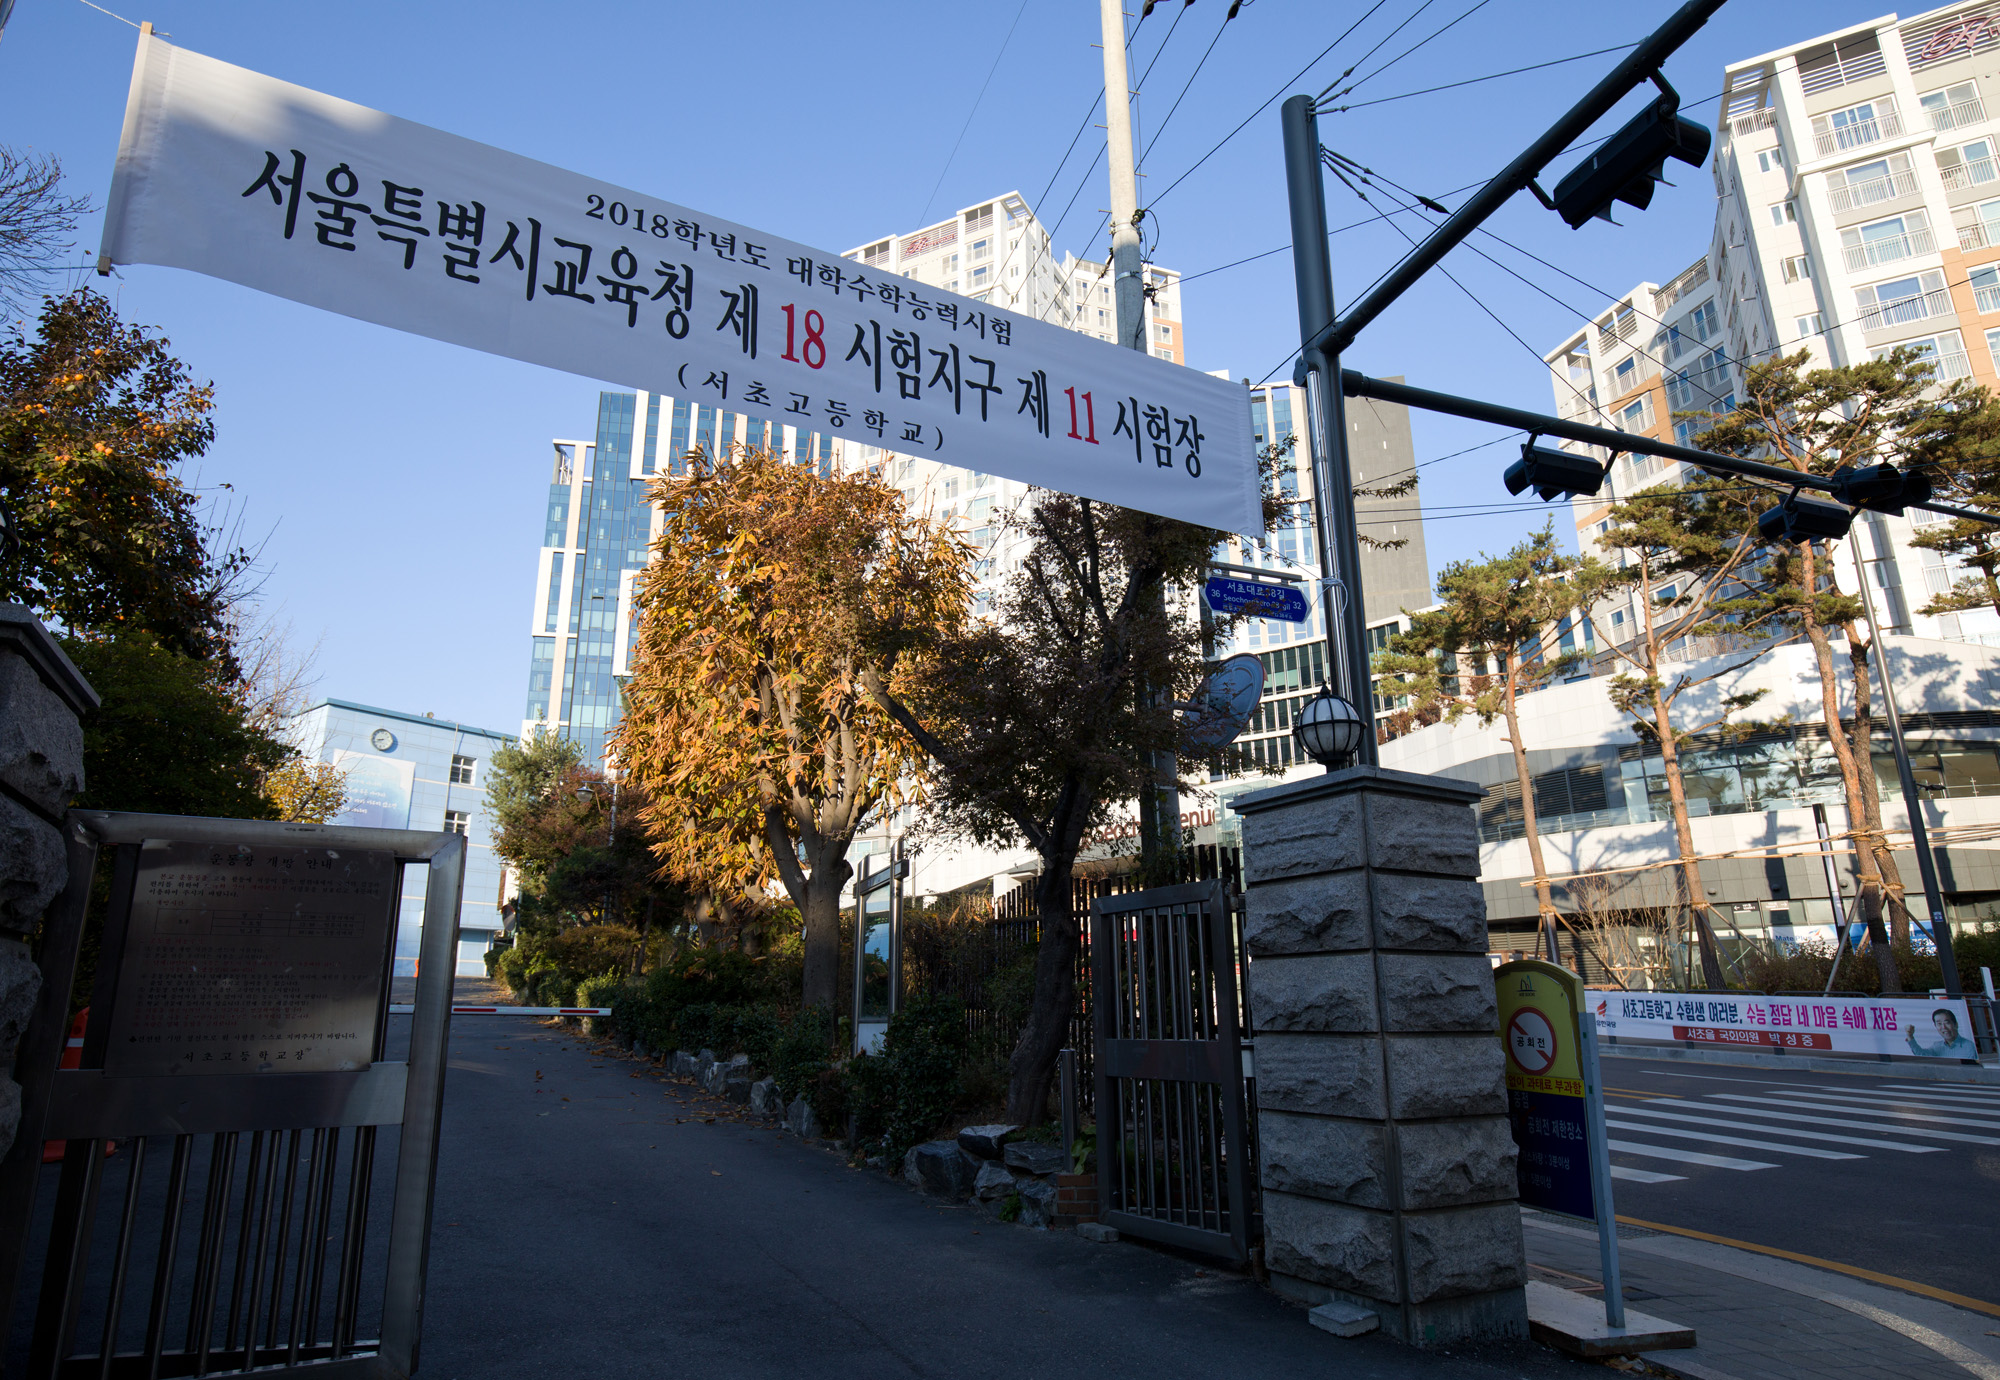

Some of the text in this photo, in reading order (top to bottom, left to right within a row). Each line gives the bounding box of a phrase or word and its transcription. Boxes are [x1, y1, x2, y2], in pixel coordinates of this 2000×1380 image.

[585, 195, 1011, 347] 2018학년도 대학수학능력시험
[242, 149, 1205, 479] 서울특별시교육청 제 18 시험지구 제 11 시험장
[1211, 588, 1221, 598] 36
[1223, 593, 1271, 607] Seochoro
[1292, 601, 1302, 610] 32
[209, 854, 332, 870] 운동장 개방 안내
[1622, 998, 1898, 1031] 서초고등학교 수험생 여러분, 수능 정답 네 마음 속에 저장
[1719, 1029, 1760, 1043] 국회의원
[1527, 1077, 1553, 1091] 과태료
[1555, 1079, 1583, 1096] 부과함
[1527, 1115, 1551, 1137] 공회전
[1551, 1119, 1584, 1141] 제한장소
